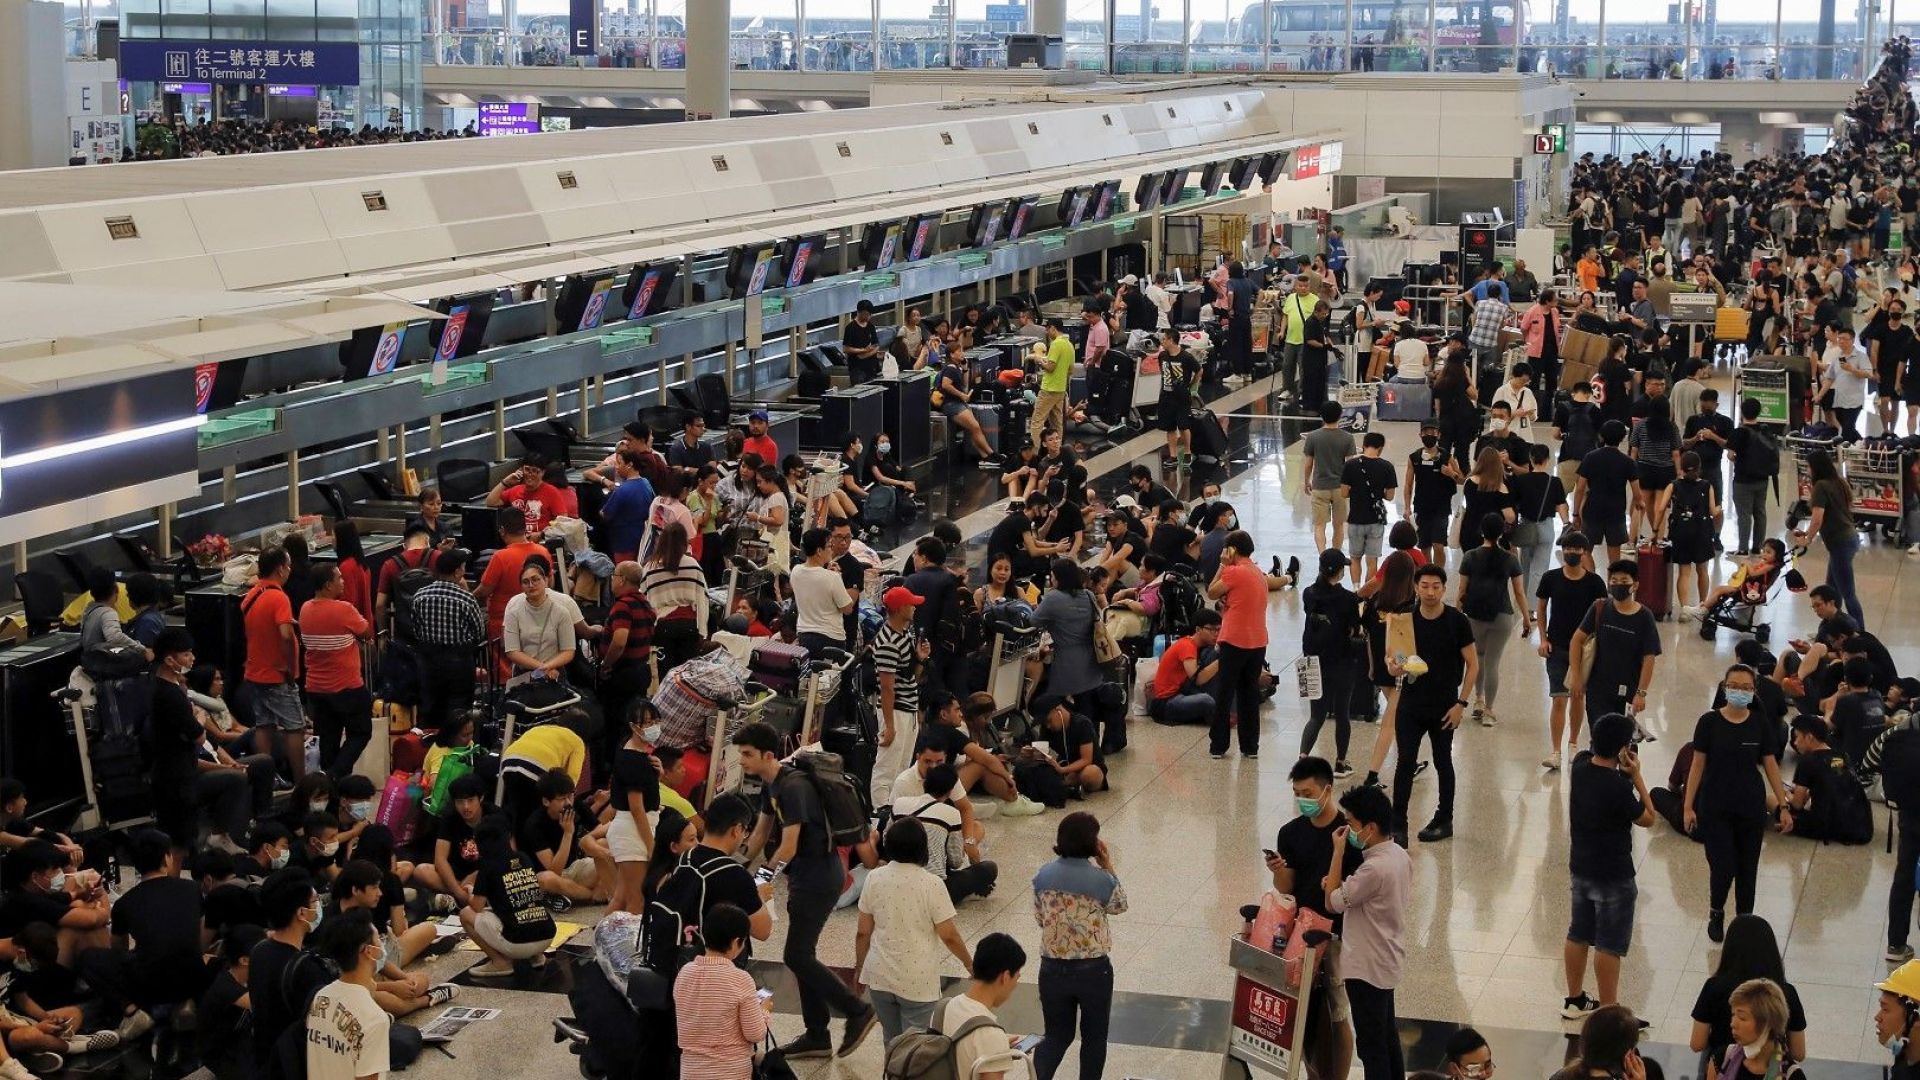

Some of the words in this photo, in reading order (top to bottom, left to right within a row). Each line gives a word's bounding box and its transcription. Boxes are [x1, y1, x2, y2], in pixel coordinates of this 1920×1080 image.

[577, 30, 588, 47] E
[195, 48, 316, 67] 往二號客運大樓
[195, 67, 209, 79] To
[209, 67, 256, 79] Terminal
[259, 68, 267, 79] 2
[82, 87, 91, 110] E
